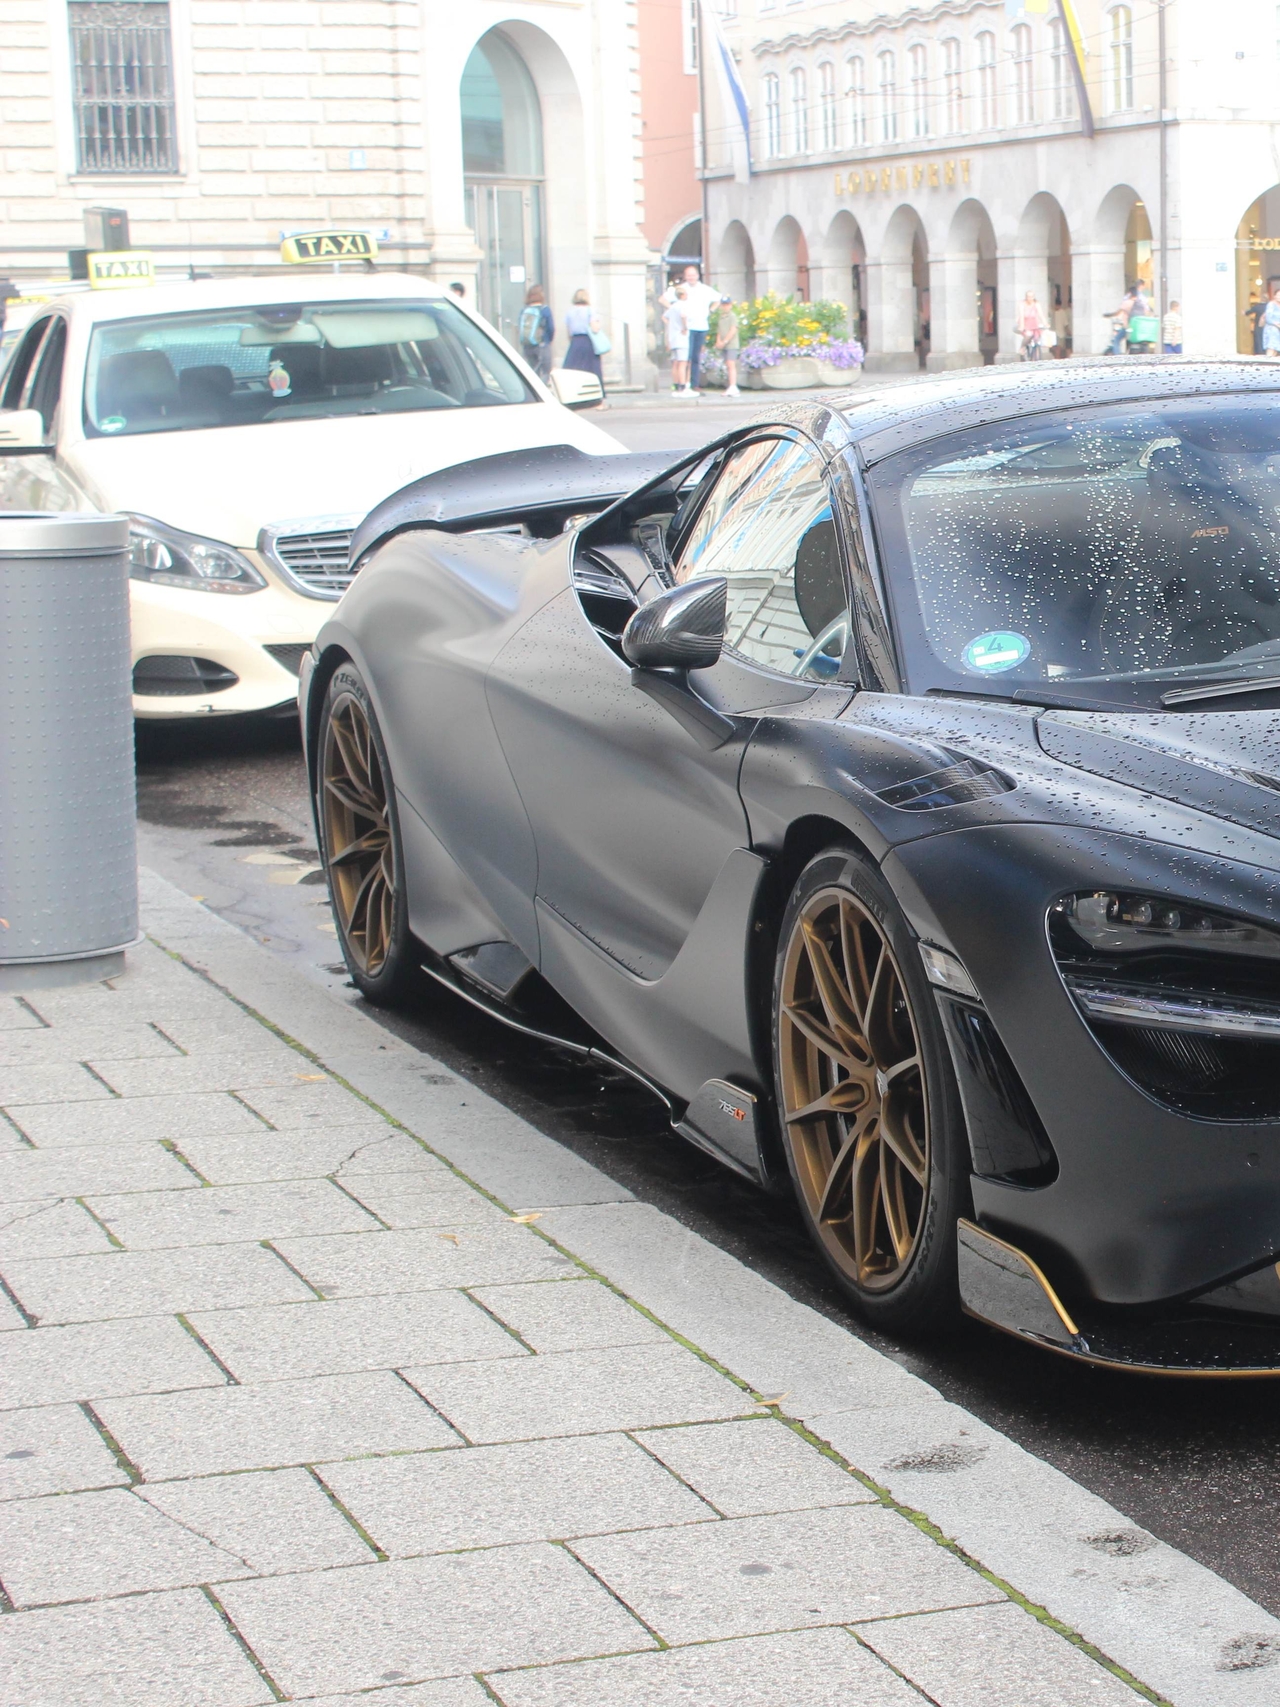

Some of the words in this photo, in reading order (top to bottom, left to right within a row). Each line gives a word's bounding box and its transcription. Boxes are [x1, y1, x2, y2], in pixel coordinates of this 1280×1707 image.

[835, 159, 971, 196] LODENFREY
[300, 235, 365, 256] TAXI
[97, 261, 149, 278] TAXI
[1190, 526, 1229, 539] MSO
[988, 636, 1003, 652] 4
[719, 1099, 746, 1121] 765LT
